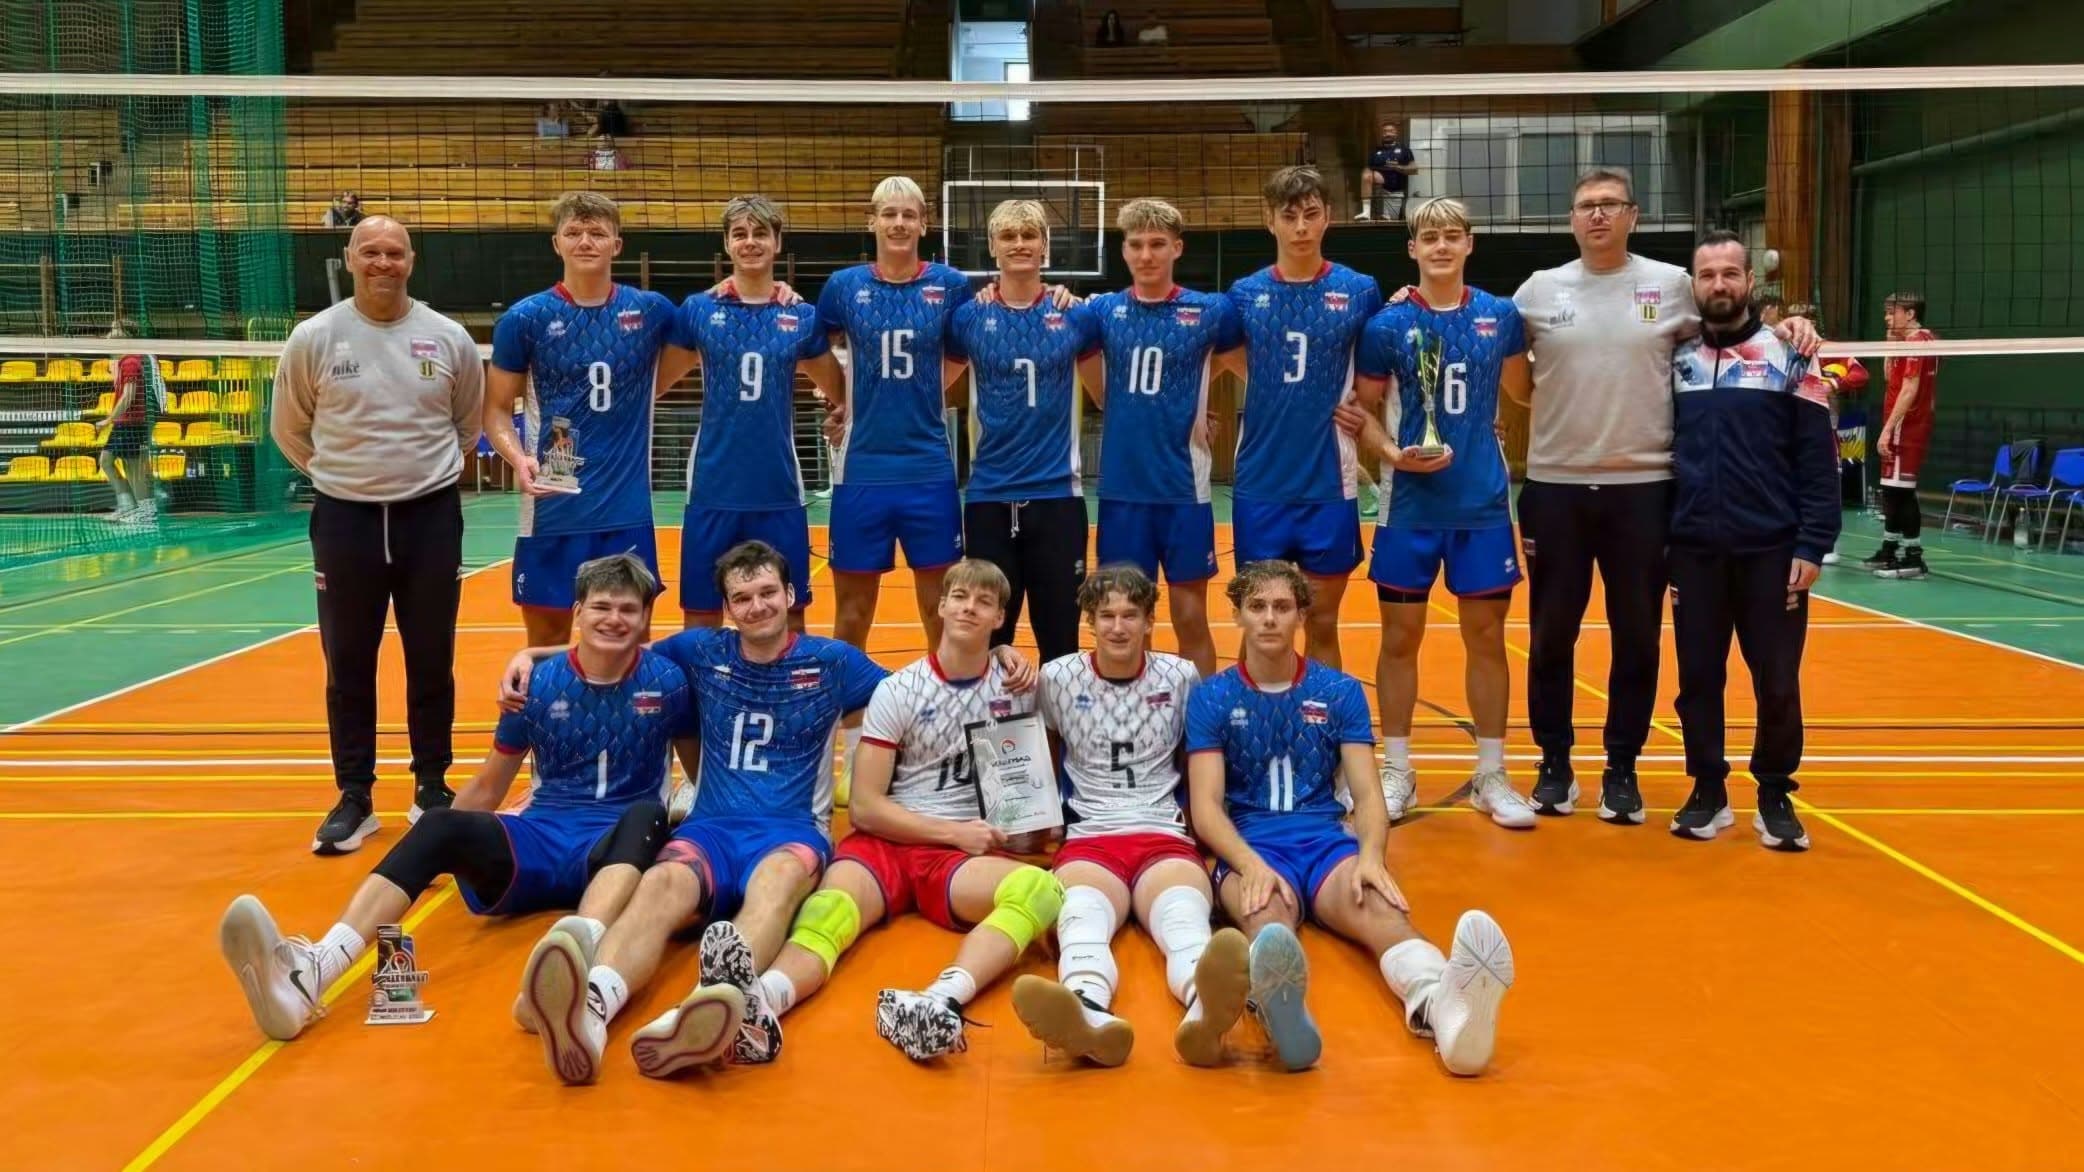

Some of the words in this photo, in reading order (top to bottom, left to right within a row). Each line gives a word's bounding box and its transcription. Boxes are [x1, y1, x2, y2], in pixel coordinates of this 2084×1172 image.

[739, 351, 764, 401] 9
[880, 329, 915, 380] 15
[1128, 346, 1164, 396] 10
[1283, 331, 1308, 384] 3
[588, 361, 612, 412] 8
[1013, 358, 1036, 408] 7
[1444, 362, 1467, 415] 6
[728, 711, 775, 772] 12
[595, 749, 608, 800] 1
[1269, 754, 1294, 812] 11
